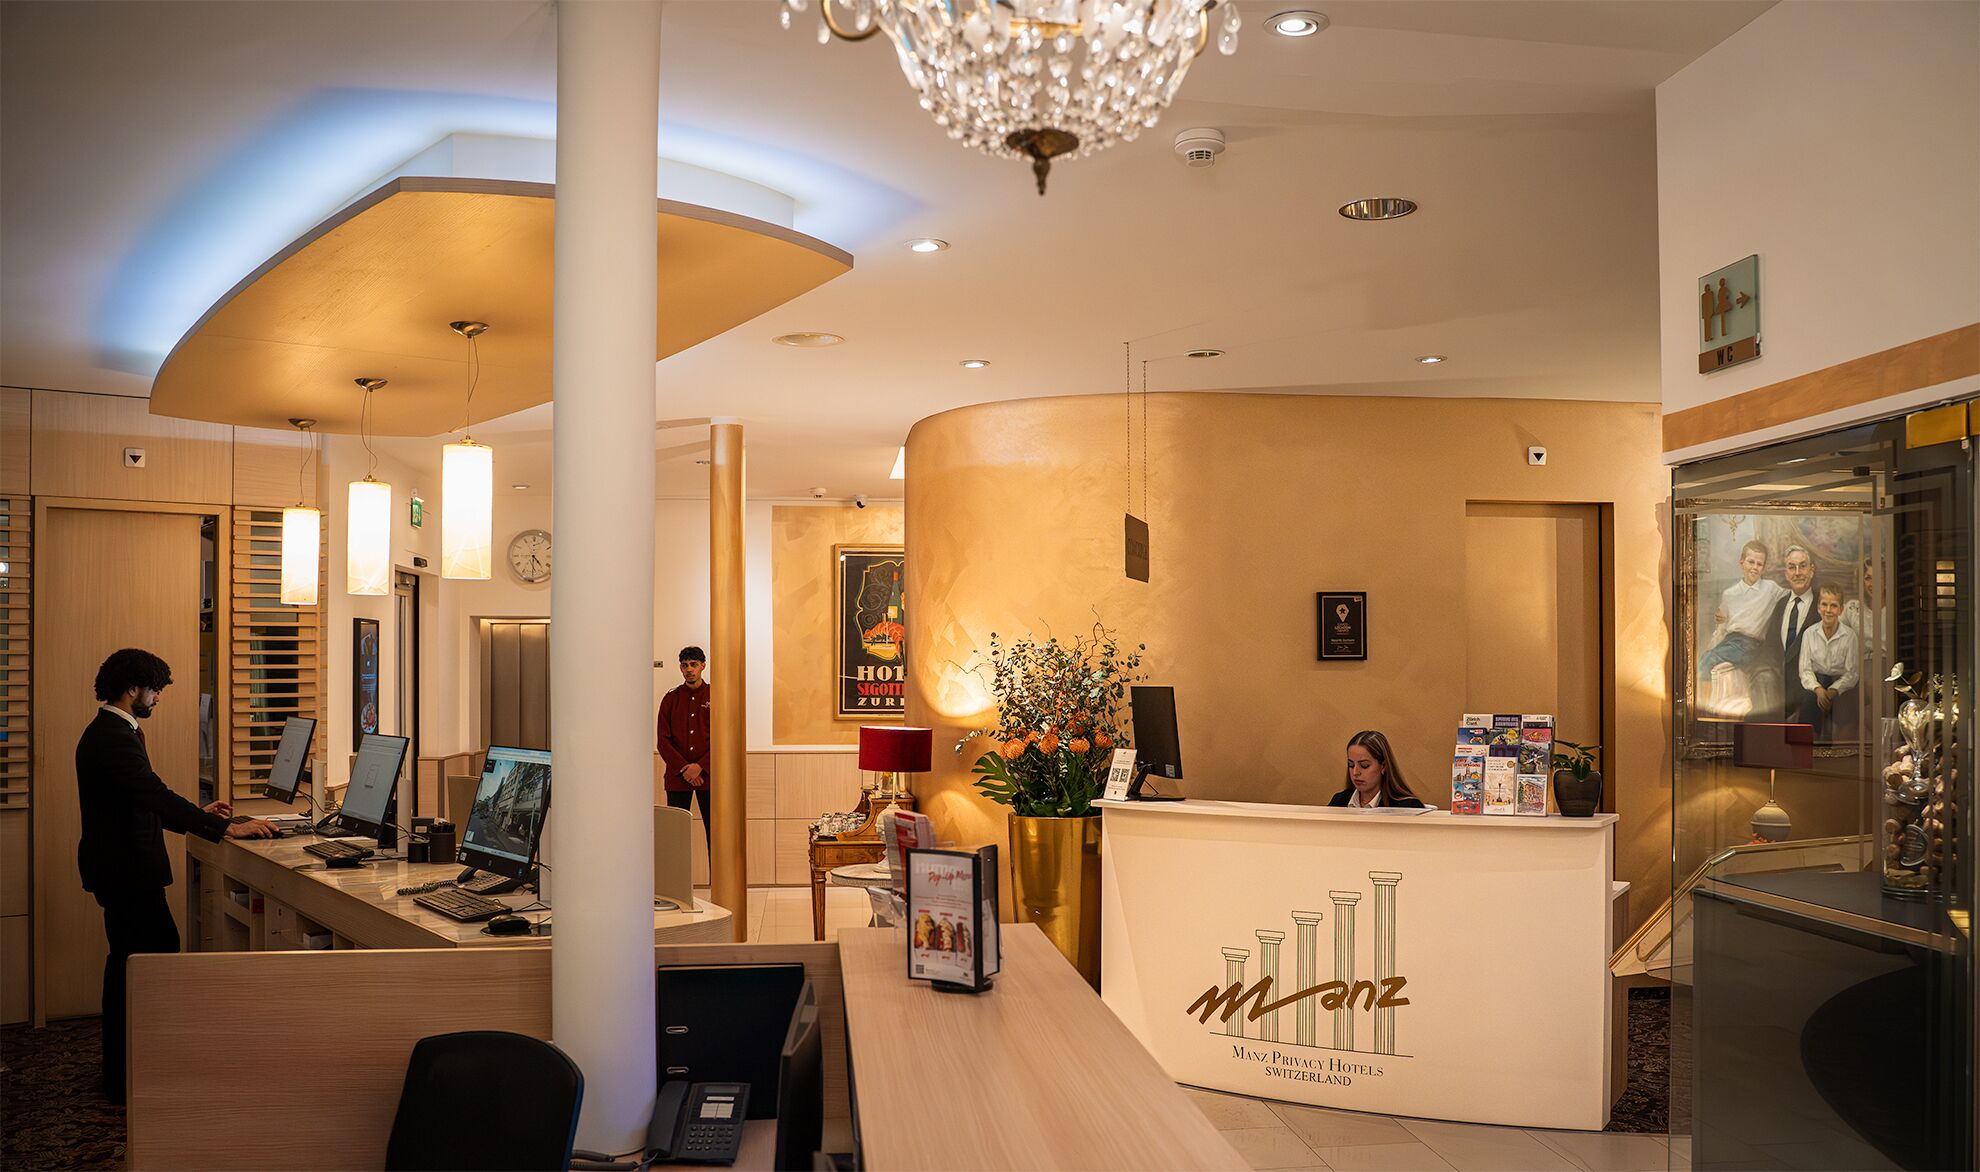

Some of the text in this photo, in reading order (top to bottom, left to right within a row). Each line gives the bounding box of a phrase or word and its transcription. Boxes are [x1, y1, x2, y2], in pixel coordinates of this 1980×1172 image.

[1716, 346, 1733, 366] WC
[857, 665, 904, 681] HOT
[857, 697, 904, 706] ZURI
[1265, 1066, 1352, 1087] SWITZERLAND
